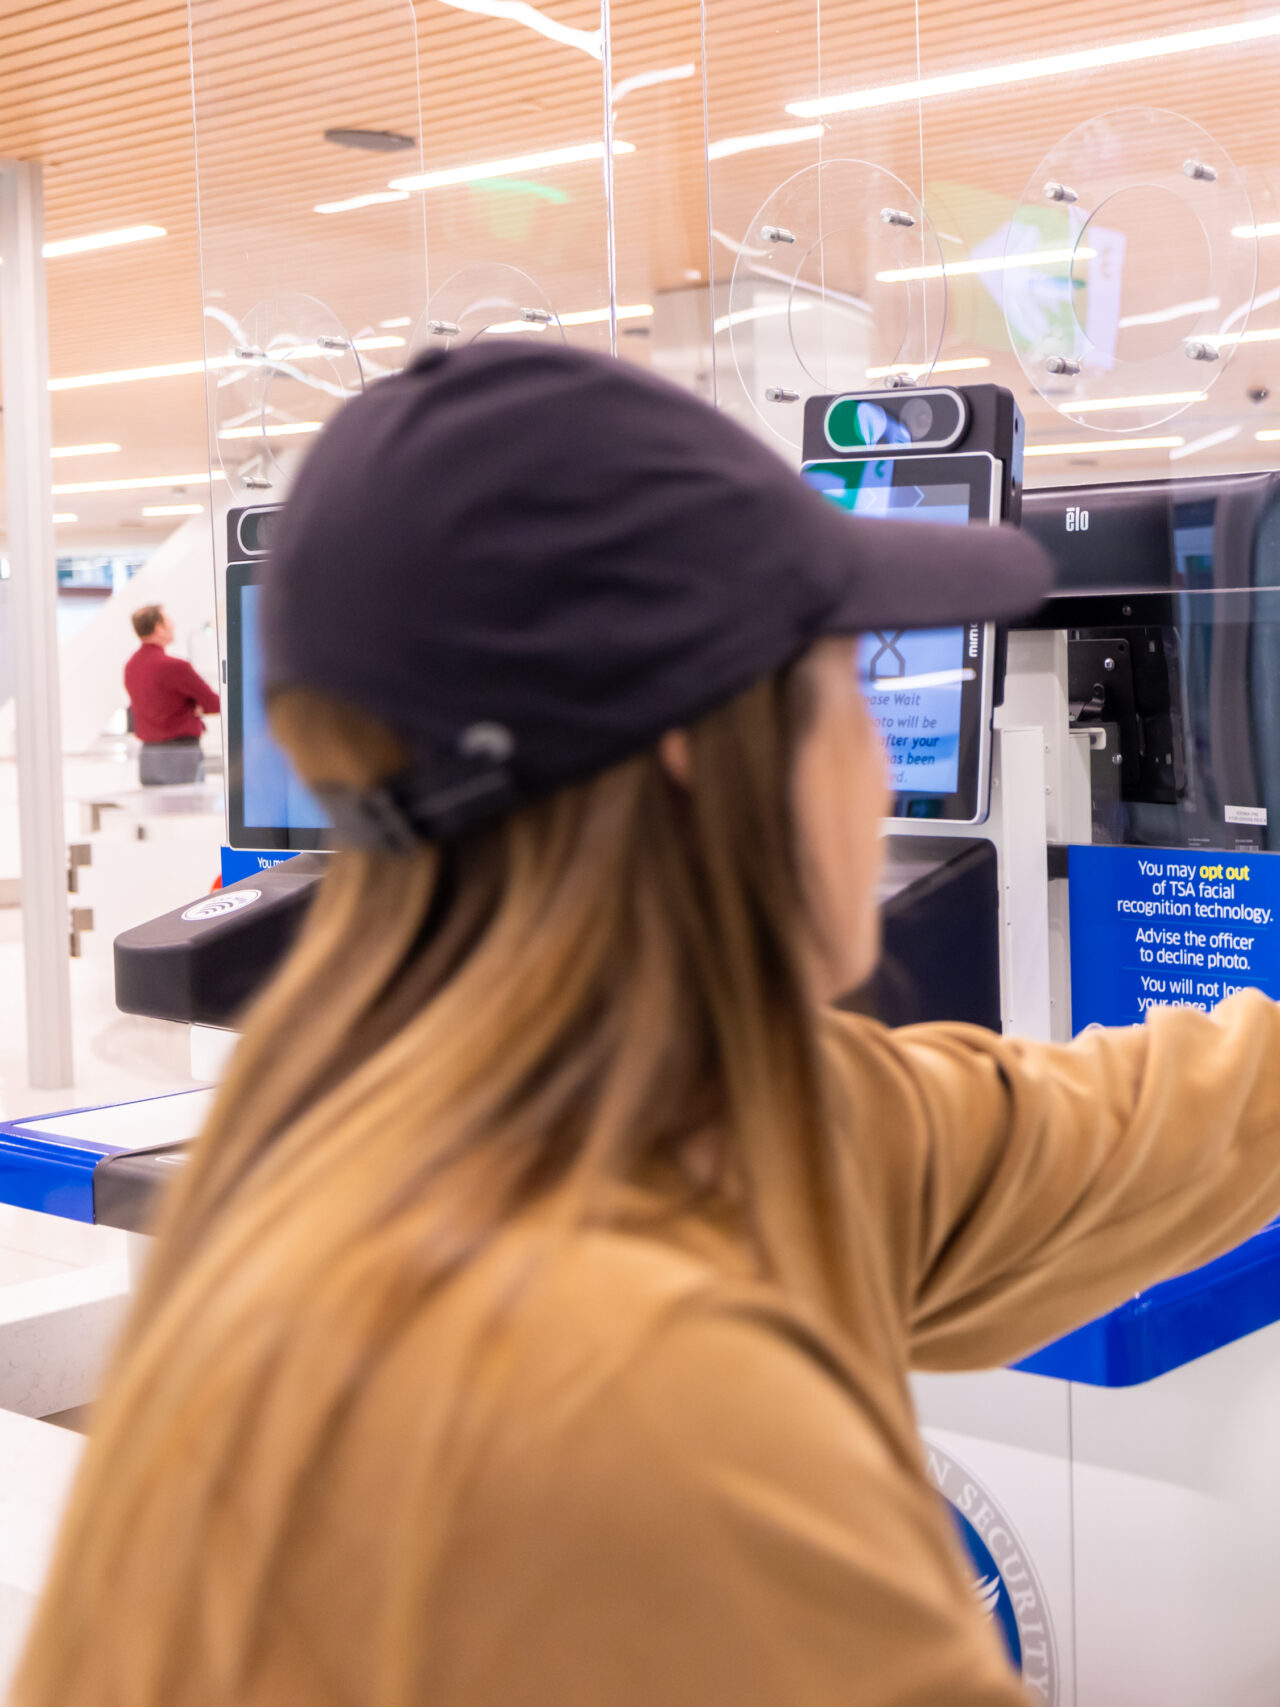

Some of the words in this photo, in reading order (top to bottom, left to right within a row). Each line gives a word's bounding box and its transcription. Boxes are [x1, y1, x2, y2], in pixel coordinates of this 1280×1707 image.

[894, 694, 921, 706] Wait
[897, 716, 919, 728] will
[922, 716, 938, 729] be
[912, 736, 940, 749] your
[906, 752, 936, 765] been
[257, 857, 272, 868] You
[1138, 860, 1163, 876] You
[1167, 864, 1196, 880] may
[1199, 864, 1223, 881] opt
[1226, 865, 1250, 881] out
[1152, 880, 1166, 895] of
[1169, 881, 1195, 897] TSA
[1199, 882, 1235, 899] facial
[1117, 899, 1191, 916] recognition
[1194, 902, 1273, 924] technology.
[1136, 928, 1181, 945] Advise
[1184, 931, 1206, 947] the
[1209, 932, 1254, 950] officer
[1140, 947, 1153, 962] to
[1156, 948, 1204, 966] decline
[1208, 952, 1251, 970] photo.
[1141, 976, 1165, 992] You
[1169, 978, 1193, 995] will
[1197, 982, 1219, 997] not
[1223, 982, 1246, 998] los
[956, 1483, 1049, 1699] SECURITY
